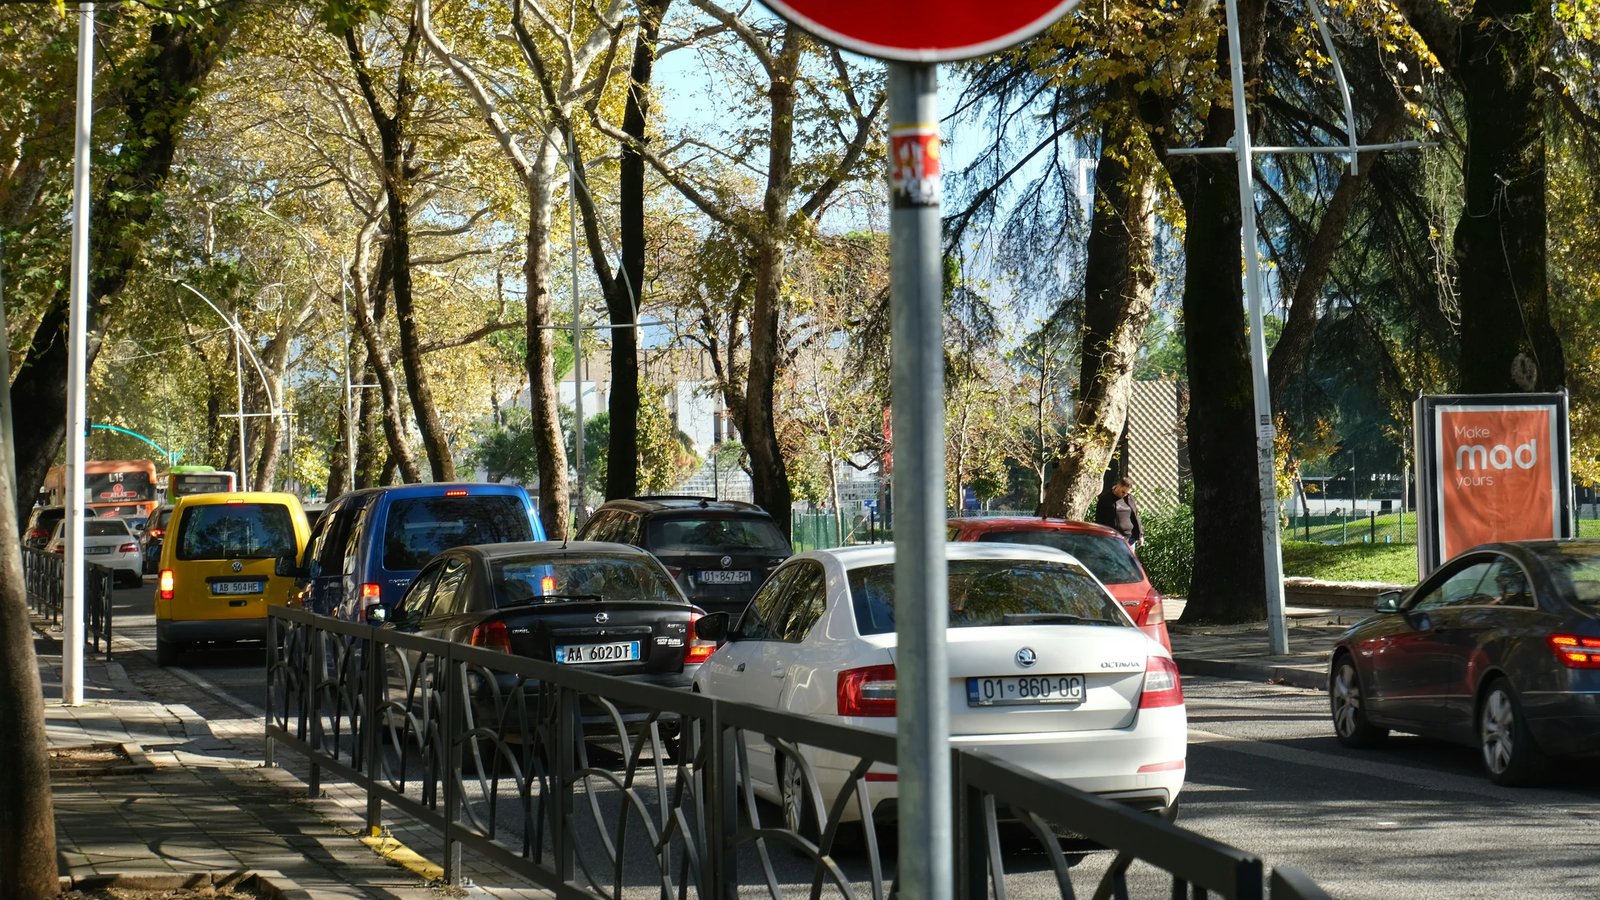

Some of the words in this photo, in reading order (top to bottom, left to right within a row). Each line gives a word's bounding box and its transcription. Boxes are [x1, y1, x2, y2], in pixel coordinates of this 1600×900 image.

[1454, 426, 1491, 439] Make
[1456, 438, 1537, 470] mad
[109, 472, 123, 482] L15
[1456, 475, 1494, 490] yours
[219, 583, 229, 592] AB
[567, 647, 583, 662] AA
